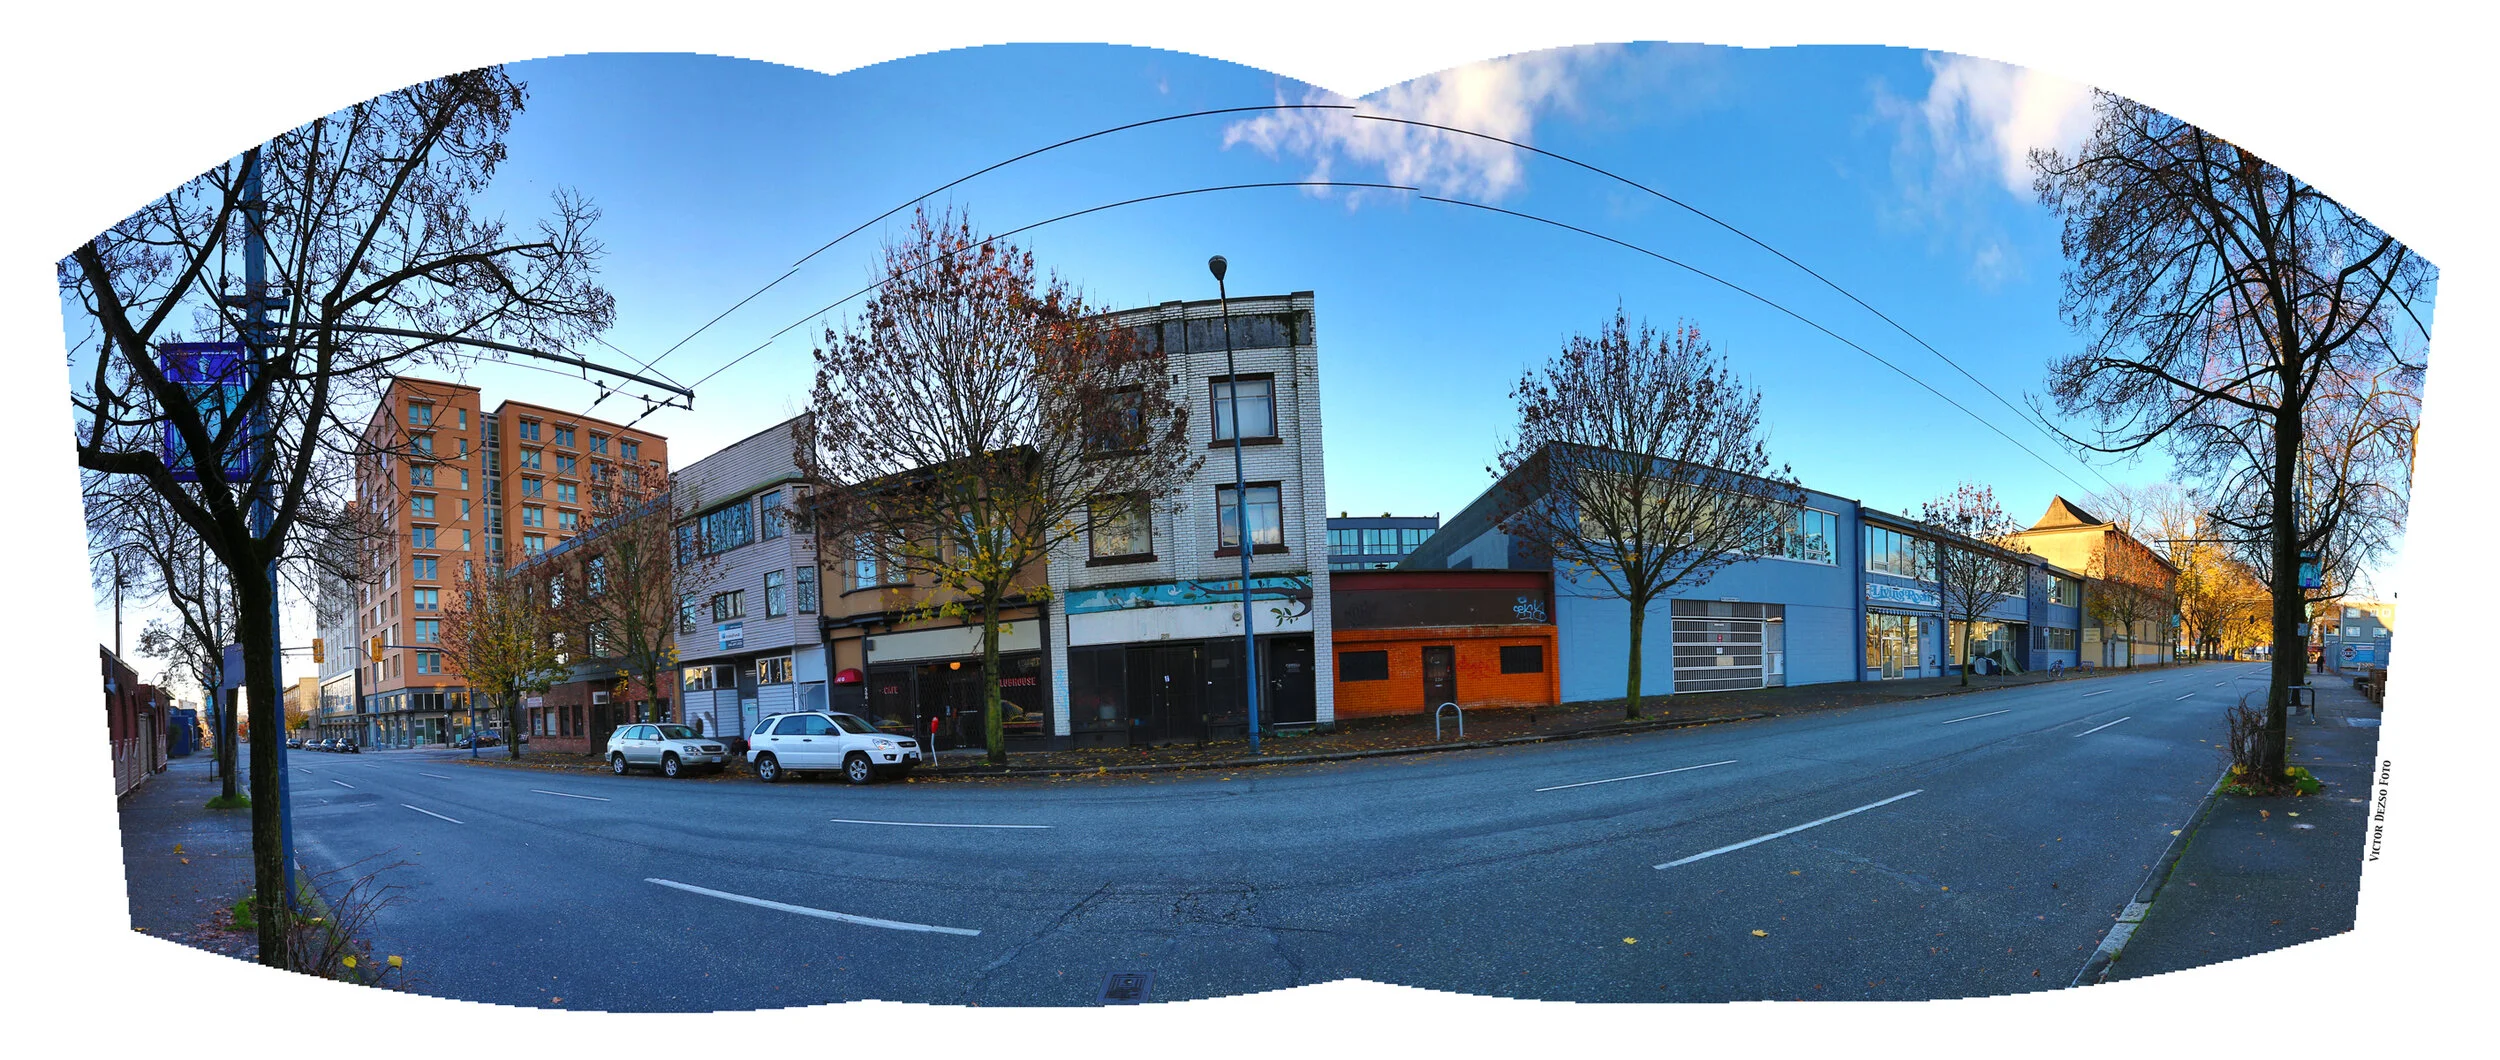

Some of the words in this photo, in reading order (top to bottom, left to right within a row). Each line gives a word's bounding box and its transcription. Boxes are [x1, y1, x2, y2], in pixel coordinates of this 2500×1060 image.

[1869, 585, 1905, 602] Living
[1000, 676, 1037, 687] LUBHOUSE
[883, 686, 899, 694] CAFE
